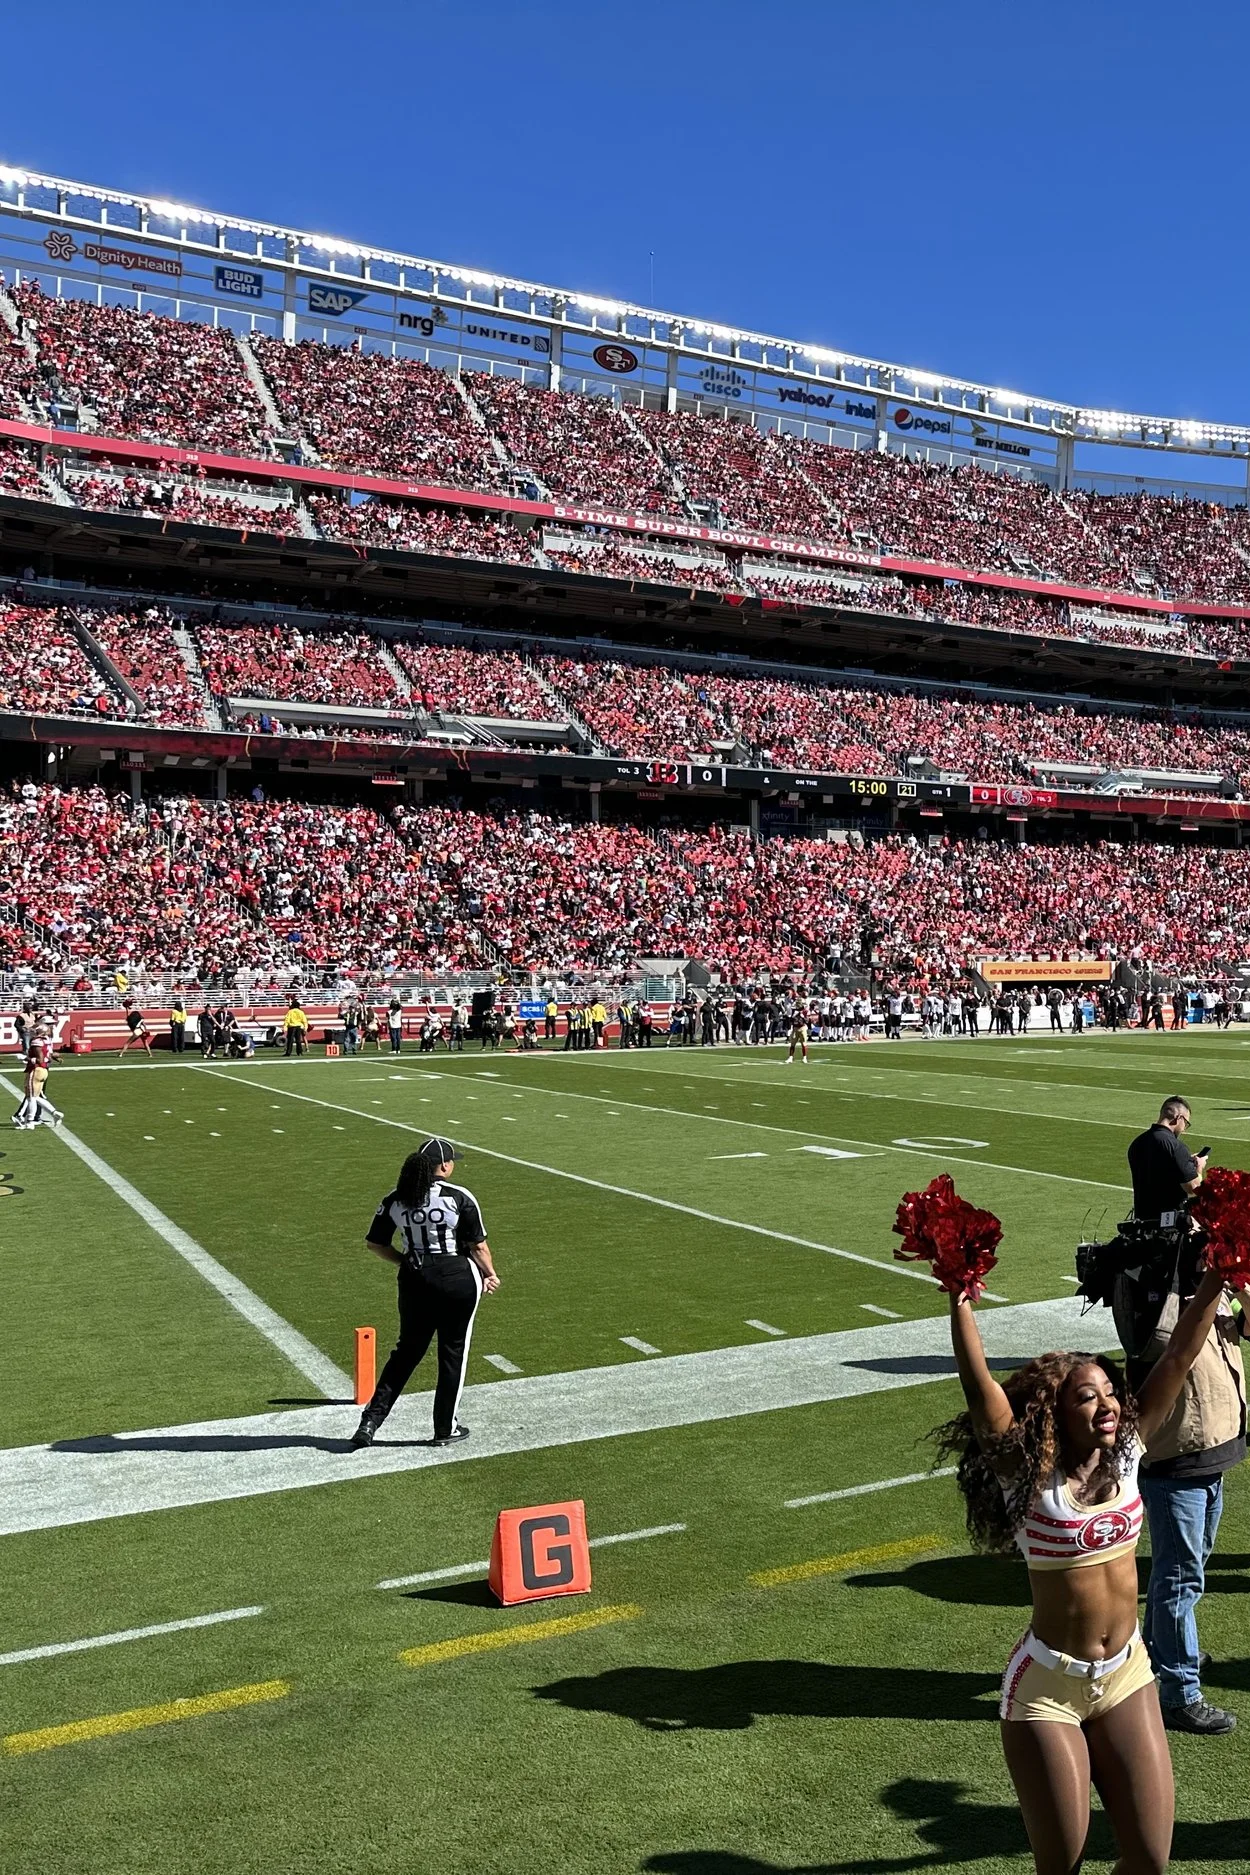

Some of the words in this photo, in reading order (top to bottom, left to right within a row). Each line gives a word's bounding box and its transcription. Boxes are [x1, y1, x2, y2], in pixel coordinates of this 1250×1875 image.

[85, 245, 135, 269] Dignity
[137, 256, 182, 276] Health
[223, 269, 255, 285] BUD
[217, 278, 261, 297] LIGHT
[310, 289, 353, 312] SAP
[399, 311, 435, 336] nrg
[466, 324, 531, 345] UNITED
[778, 387, 835, 408] yahoo!
[913, 416, 951, 435] pepsi
[995, 440, 1031, 457] MELLON
[553, 505, 629, 527] 5-TIME
[633, 518, 702, 538] SUPER
[707, 529, 765, 548] BOWL
[769, 538, 883, 567] CHAMPIONS
[633, 767, 640, 775] 3
[702, 770, 713, 782] 0
[849, 780, 887, 795] 15:00
[901, 785, 913, 795] 21
[980, 789, 990, 800] 0
[990, 968, 1012, 976] SAN
[1014, 968, 1072, 976] FRANCISCO
[328, 1044, 338, 1056] 10
[400, 1207, 445, 1226] 100
[518, 1514, 574, 1591] G
